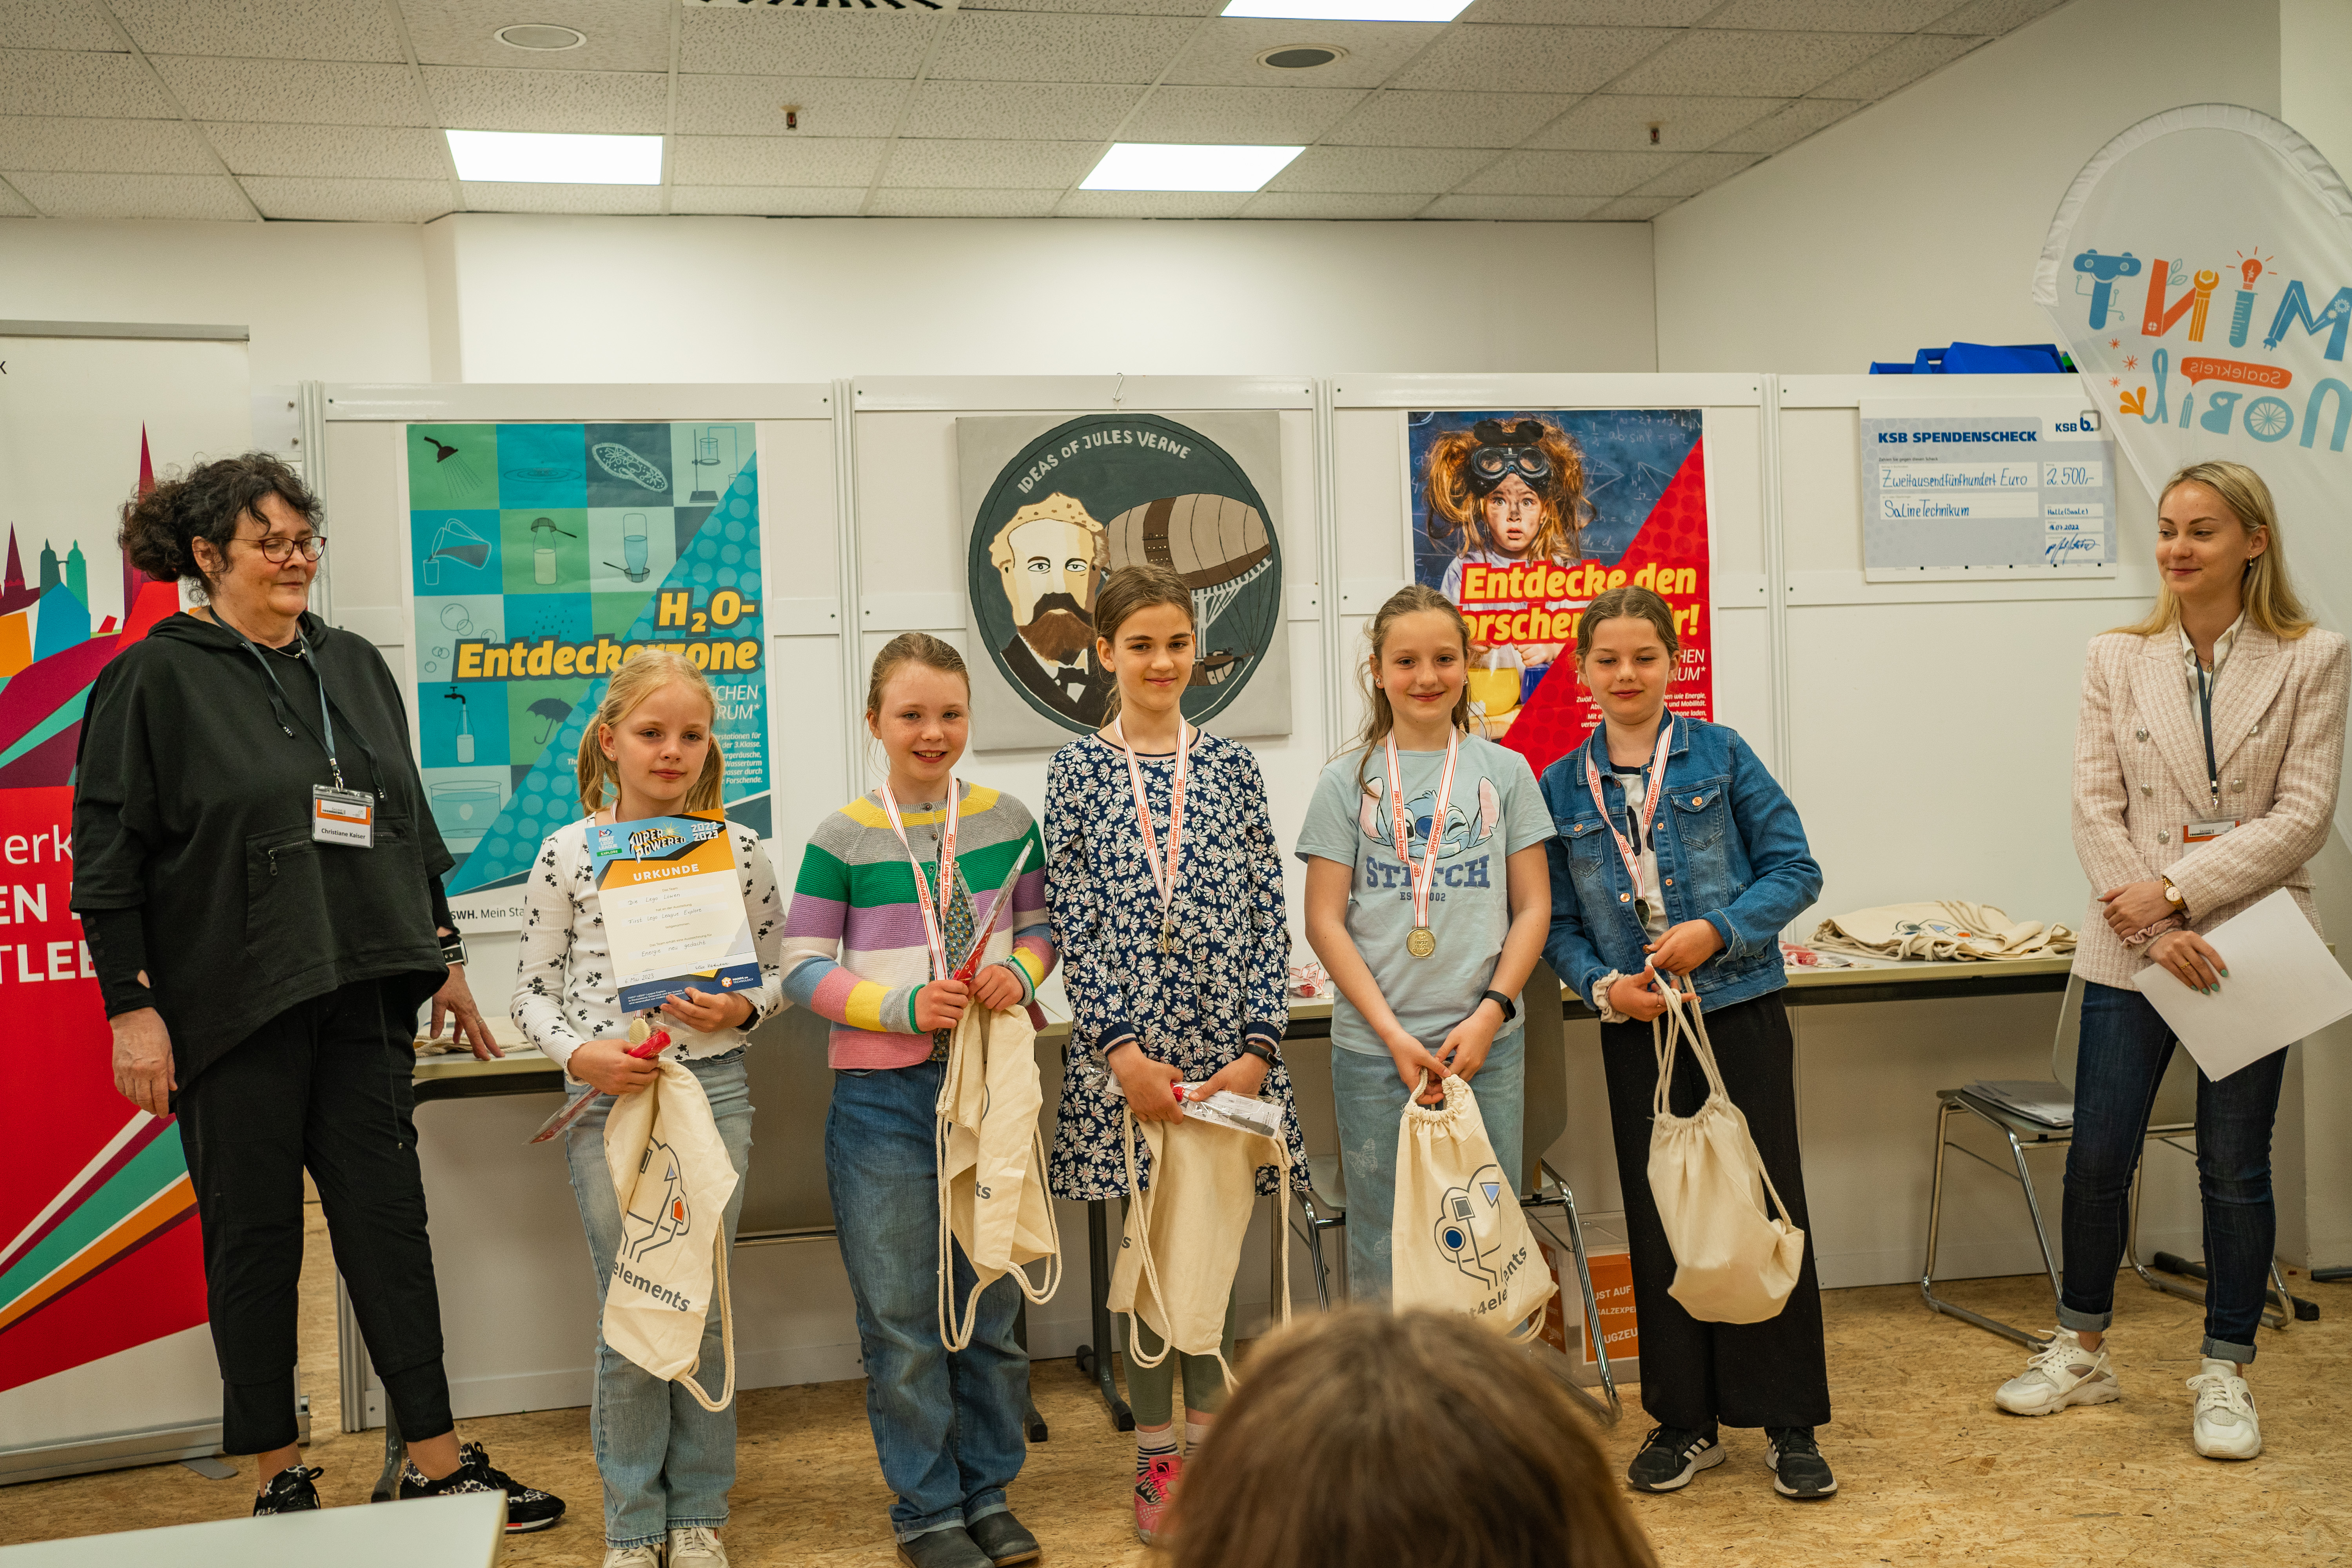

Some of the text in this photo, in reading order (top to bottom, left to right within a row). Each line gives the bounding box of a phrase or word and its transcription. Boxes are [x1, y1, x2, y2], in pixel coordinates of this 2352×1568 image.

[2055, 423, 2077, 432] KSB
[1878, 431, 2037, 443] KSB SPENDENSCHECK
[1018, 430, 1191, 494] IDEAS OF JULES VERNE
[1882, 467, 2027, 488] Zweitausendfünfhundert Euro
[1465, 563, 1697, 599] Entdecke den
[321, 828, 348, 837] Christiane
[690, 821, 718, 833] 2022
[628, 828, 664, 854] SUPER
[693, 829, 719, 842] 2023
[633, 864, 700, 882] URKUNDE
[481, 907, 506, 918] Mein
[642, 949, 661, 957] Energie
[684, 940, 706, 949] gedacht
[1613, 1285, 1632, 1297] AUF
